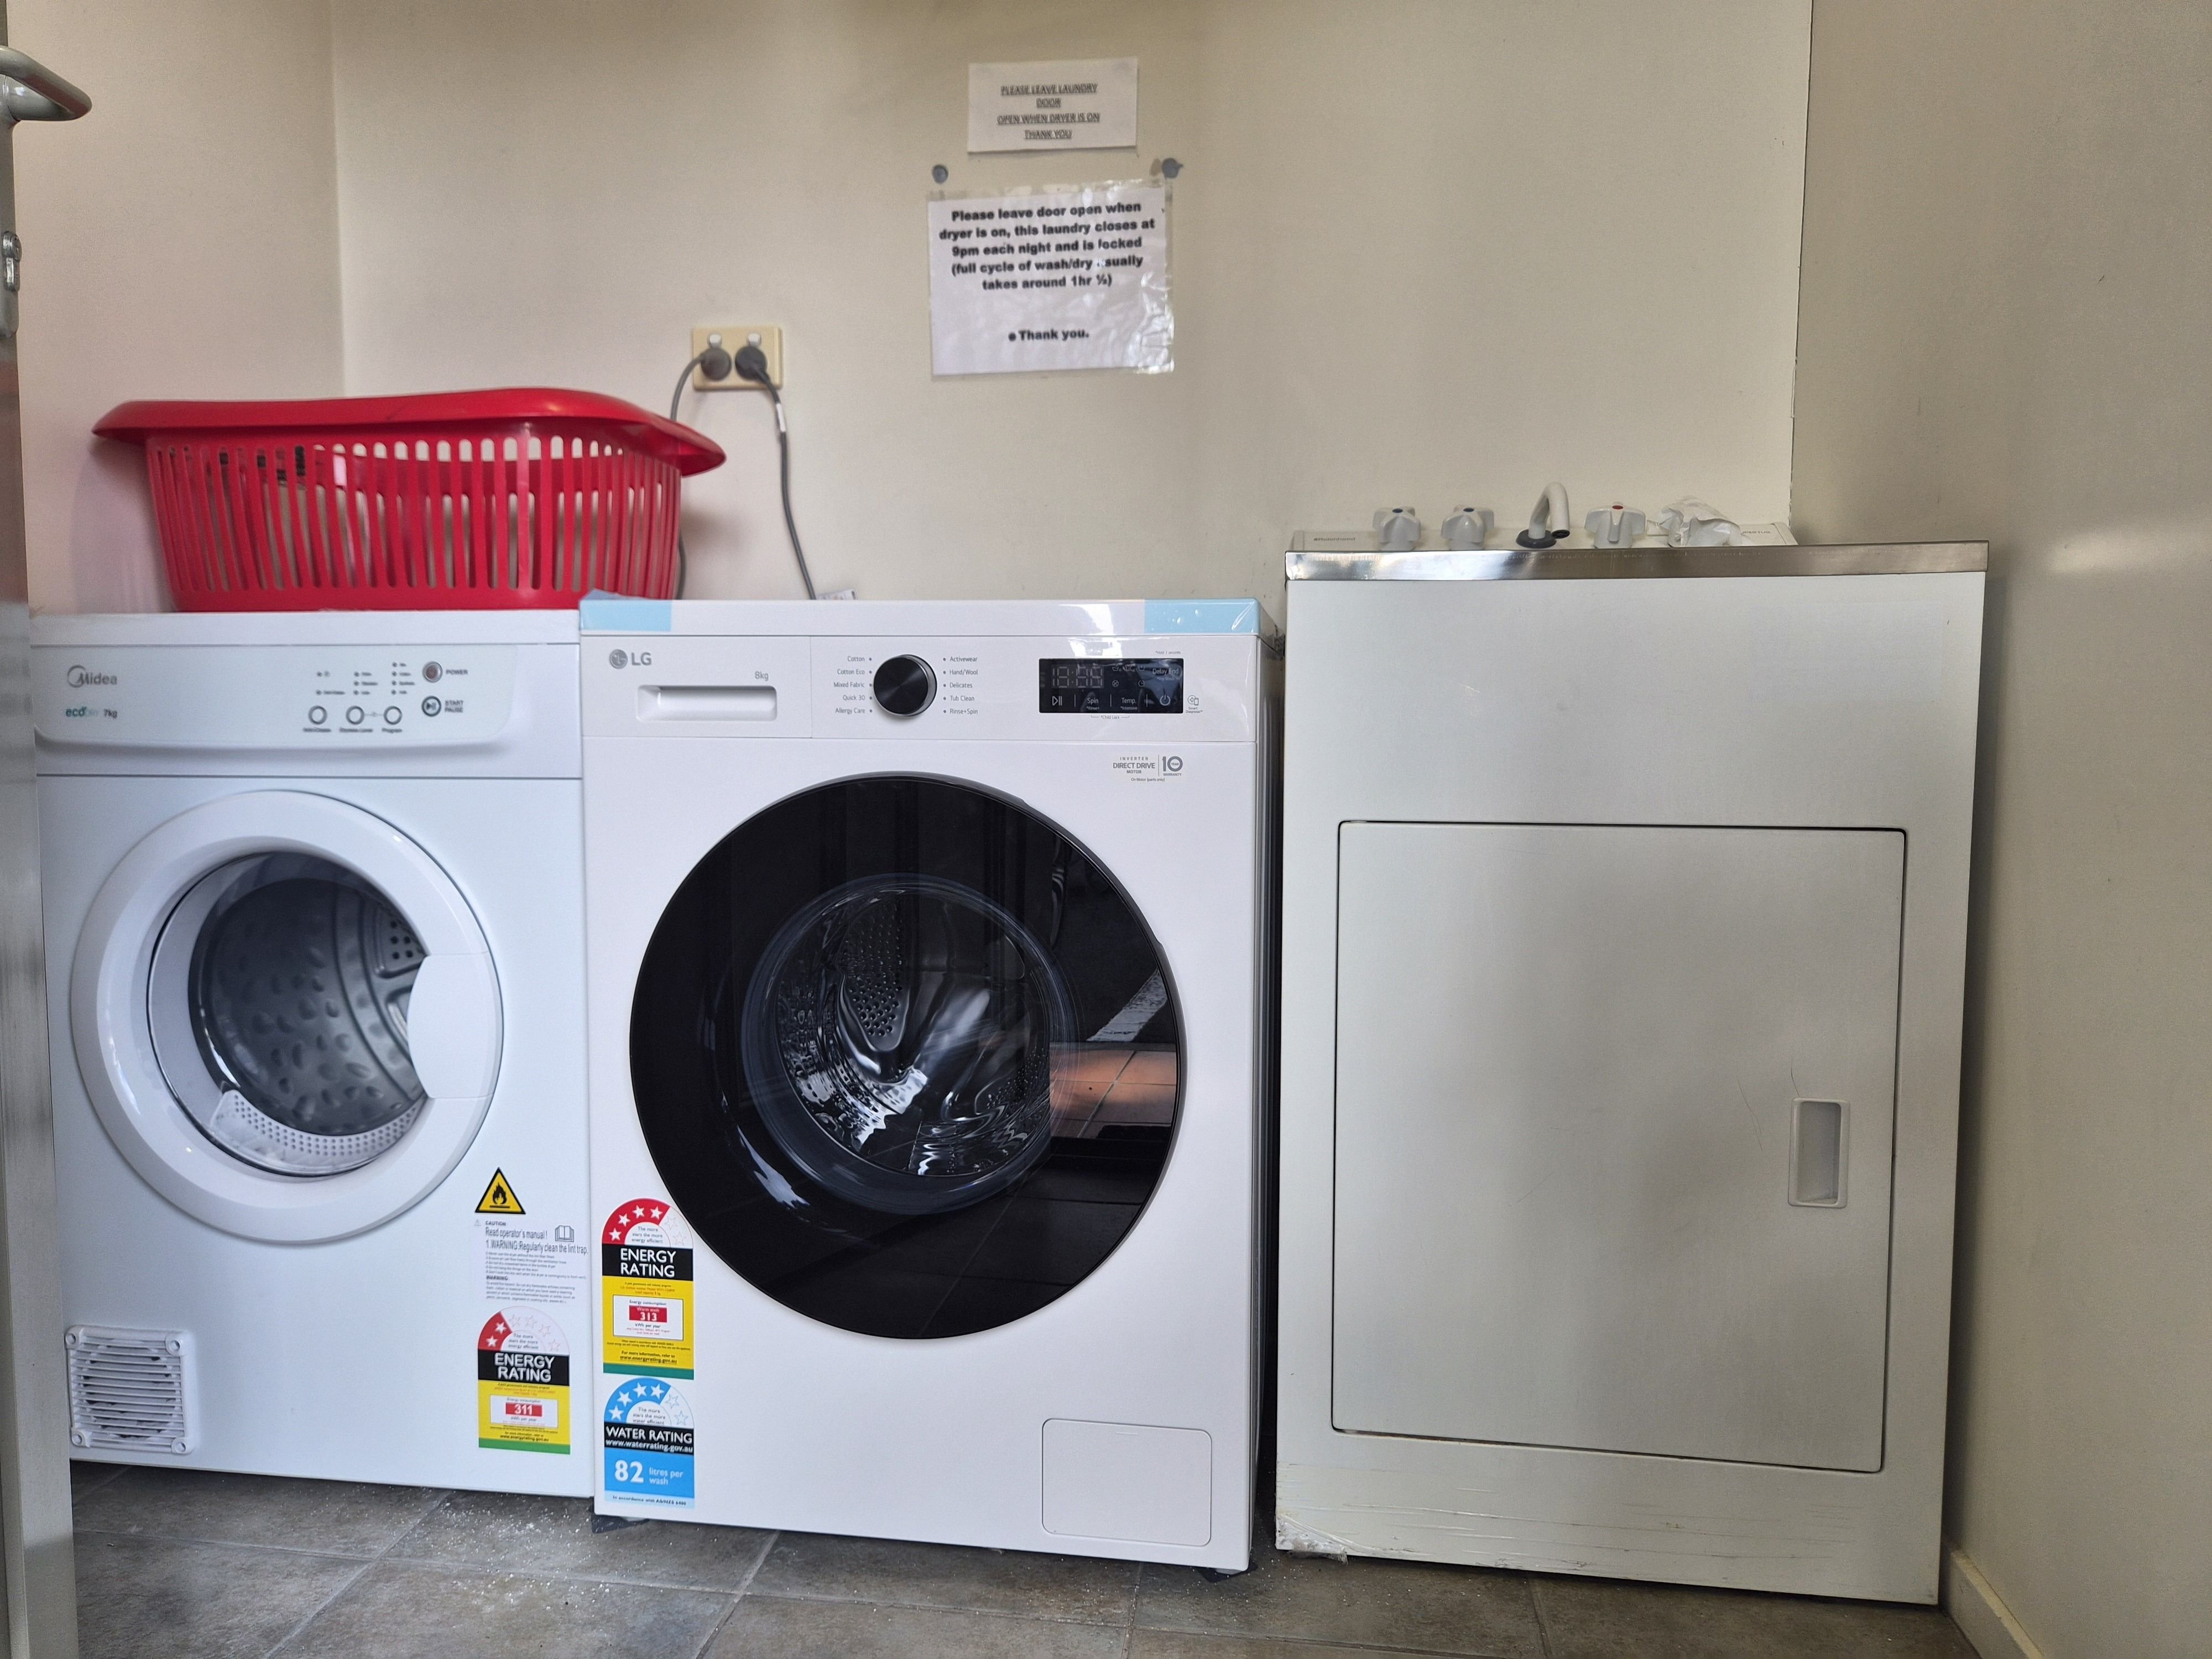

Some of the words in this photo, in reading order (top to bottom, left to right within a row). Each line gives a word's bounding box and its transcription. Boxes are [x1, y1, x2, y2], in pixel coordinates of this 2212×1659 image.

[1000, 85, 1030, 96] PLEASE
[1031, 84, 1056, 95] LEAVE
[1058, 83, 1097, 94] LAUNDRY
[1036, 97, 1061, 107] DOOR
[997, 114, 1020, 124] OPEN
[1021, 114, 1047, 124] WHEN
[1049, 113, 1077, 123] DRYER
[1078, 113, 1085, 122] IS
[1087, 112, 1099, 122] ON
[1025, 130, 1052, 139] THANK
[1053, 129, 1072, 139] YOU
[951, 210, 994, 221] Please
[998, 208, 1033, 220] leave
[1037, 207, 1066, 218] door
[1070, 205, 1102, 217] open
[1105, 202, 1141, 213] when
[939, 228, 972, 242] dryer
[976, 227, 987, 238] is
[991, 228, 1010, 238] on,
[1014, 225, 1039, 236] this
[1042, 223, 1091, 236] laundry
[1094, 221, 1138, 232] closes
[1141, 218, 1155, 229] at
[952, 245, 979, 258] 9pm
[983, 243, 1014, 255] each
[1019, 241, 1051, 255] night
[1055, 239, 1079, 252] and
[1083, 239, 1094, 251] is
[1098, 237, 1142, 249] locked
[952, 263, 976, 276] (full
[980, 260, 1015, 275] cycle
[1019, 260, 1031, 271] of
[1035, 258, 1093, 271] wash/dry
[982, 279, 1018, 290] takes
[1022, 276, 1066, 288] around
[1071, 275, 1092, 286] 1hr
[1018, 328, 1058, 341] Thank
[1062, 328, 1089, 341] you.
[631, 653, 652, 666] LG
[67, 665, 117, 688] Midea
[755, 671, 769, 681] 8kg
[103, 708, 117, 719] 7kg
[1162, 756, 1183, 772] 10
[485, 1227, 498, 1236] Read
[544, 1244, 558, 1253] clean
[559, 1244, 567, 1253] the
[568, 1244, 576, 1253] lint
[620, 1248, 676, 1263] ENERGY
[620, 1262, 675, 1278] RATING
[640, 1311, 657, 1321] 313
[494, 1353, 555, 1370] ENERGY
[498, 1366, 551, 1383] RATING
[514, 1404, 533, 1415] 311
[606, 1426, 646, 1440] WATER
[649, 1430, 692, 1444] RATING
[606, 1439, 693, 1453] www.waterrating.gov.au
[614, 1459, 644, 1483] 82
[649, 1466, 668, 1477] litres
[670, 1470, 684, 1479] per
[649, 1477, 669, 1485] wash
